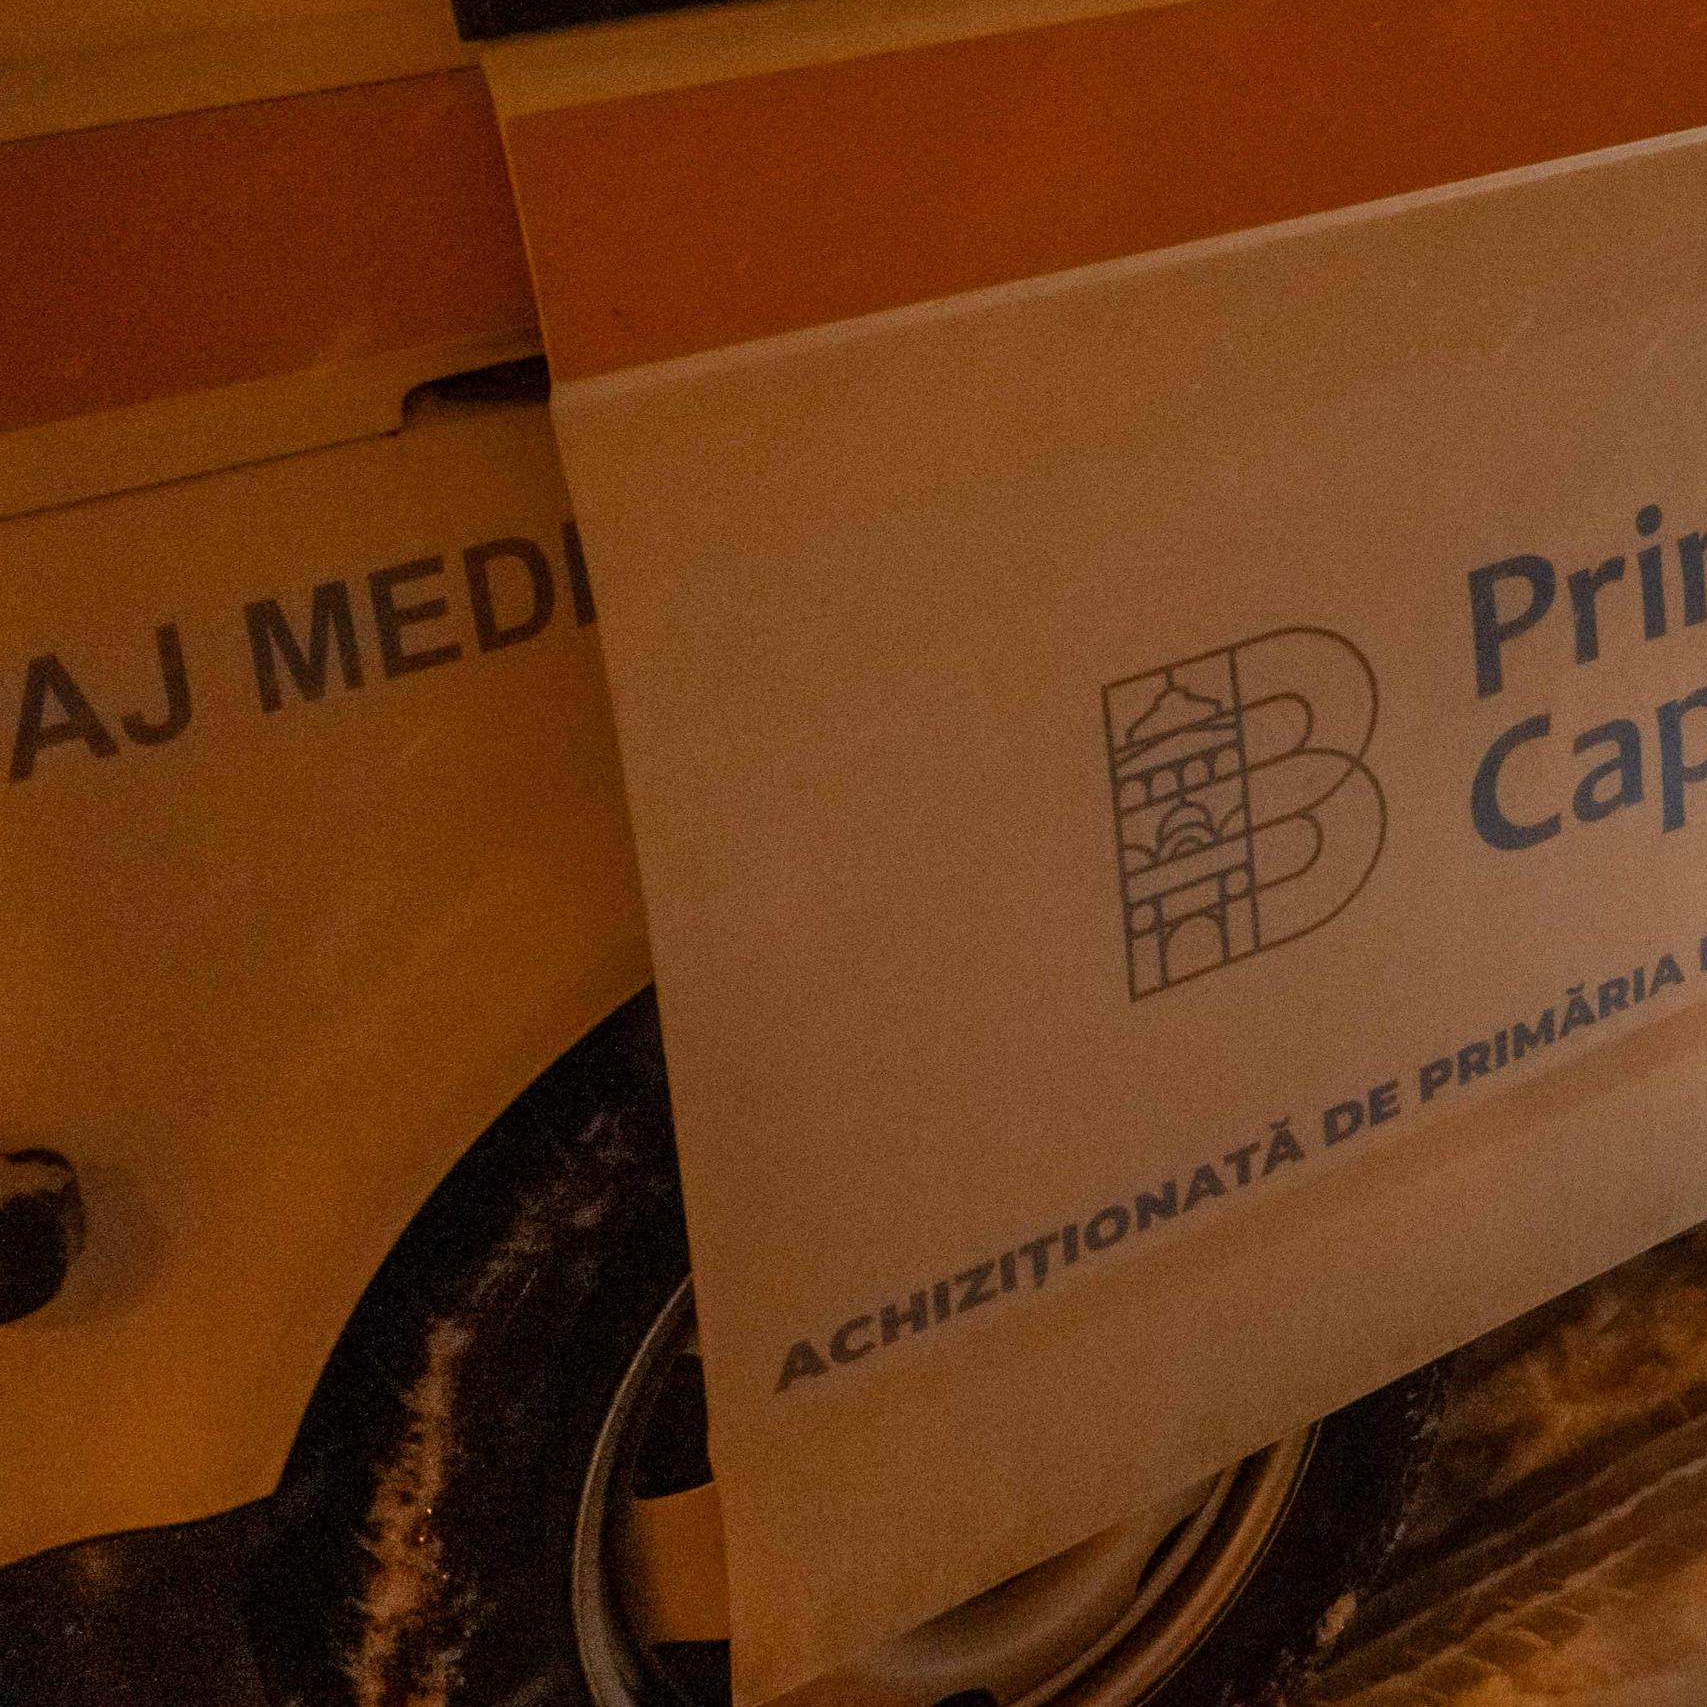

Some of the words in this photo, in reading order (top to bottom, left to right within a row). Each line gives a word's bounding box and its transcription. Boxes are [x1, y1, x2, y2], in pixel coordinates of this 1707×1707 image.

[8, 623, 193, 785] AJ
[774, 1117, 1307, 1393] ACHIZIȚIONATĂ
[1323, 1078, 1402, 1148] DE
[1419, 952, 1686, 1105] PRIMĂRIA
